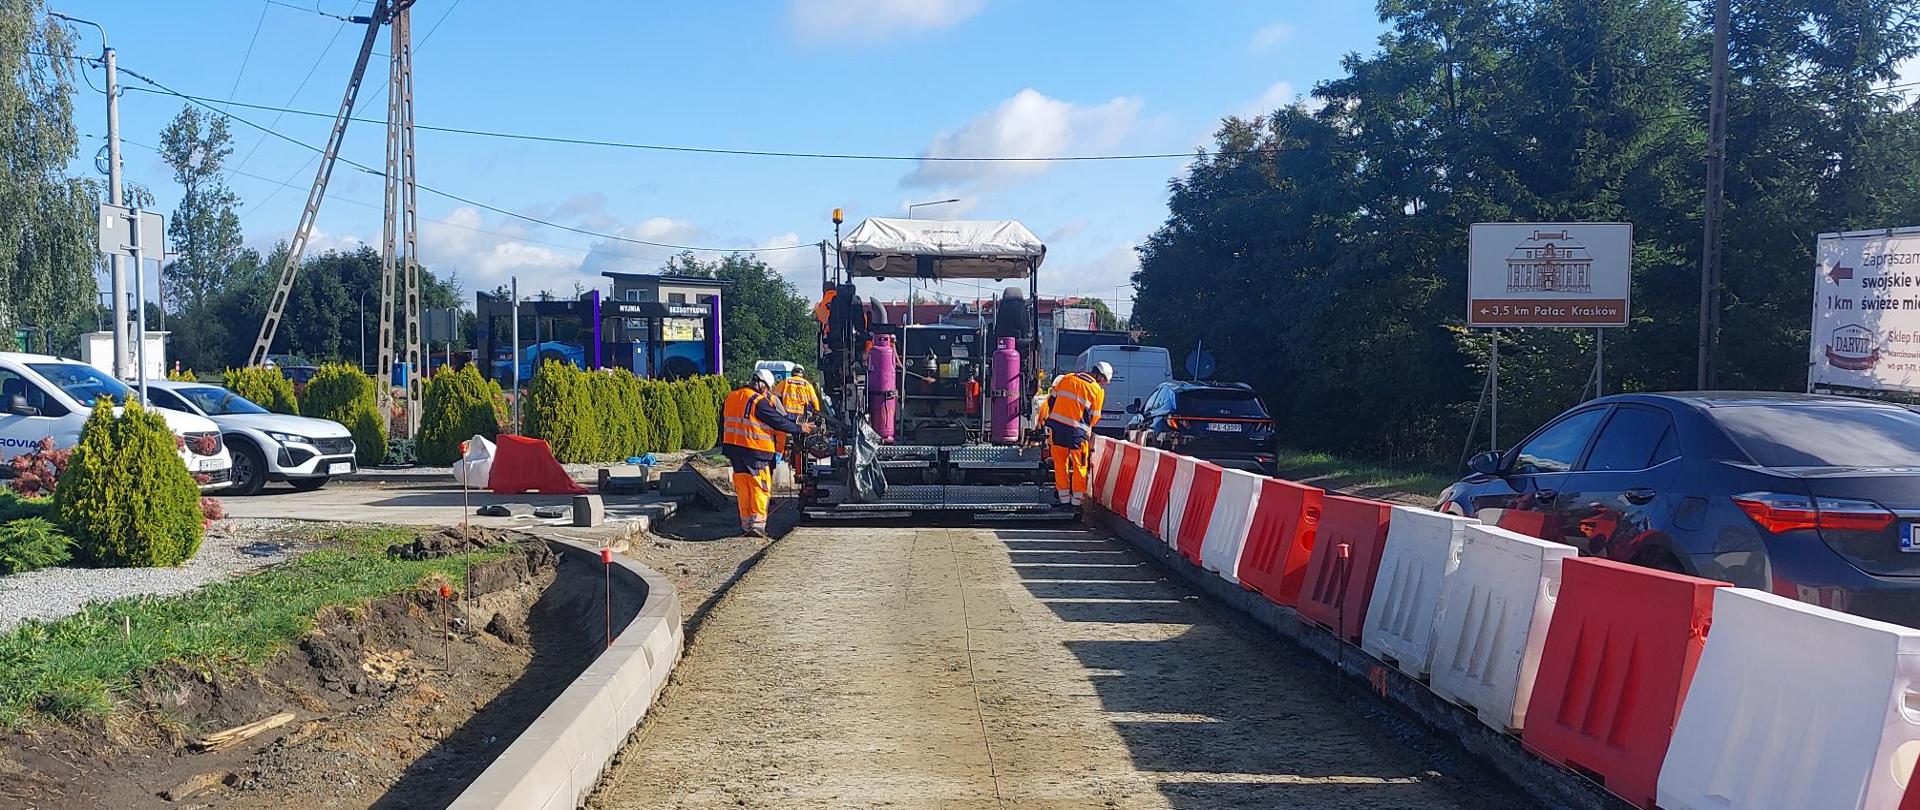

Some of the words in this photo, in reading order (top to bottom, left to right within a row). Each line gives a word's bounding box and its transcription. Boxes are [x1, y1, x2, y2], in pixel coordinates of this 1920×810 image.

[1862, 272, 1912, 290] swojskie
[1828, 296, 1832, 309] 1
[1834, 295, 1853, 309] km
[1861, 295, 1899, 310] świeże
[1492, 305, 1510, 317] 3,5
[1514, 305, 1530, 316] km
[1534, 305, 1565, 316] Pałac
[1571, 305, 1617, 316] Krasków
[1836, 336, 1870, 354] DARVIT
[1888, 330, 1911, 345] Sklep
[1887, 350, 1920, 359] Marcinowi
